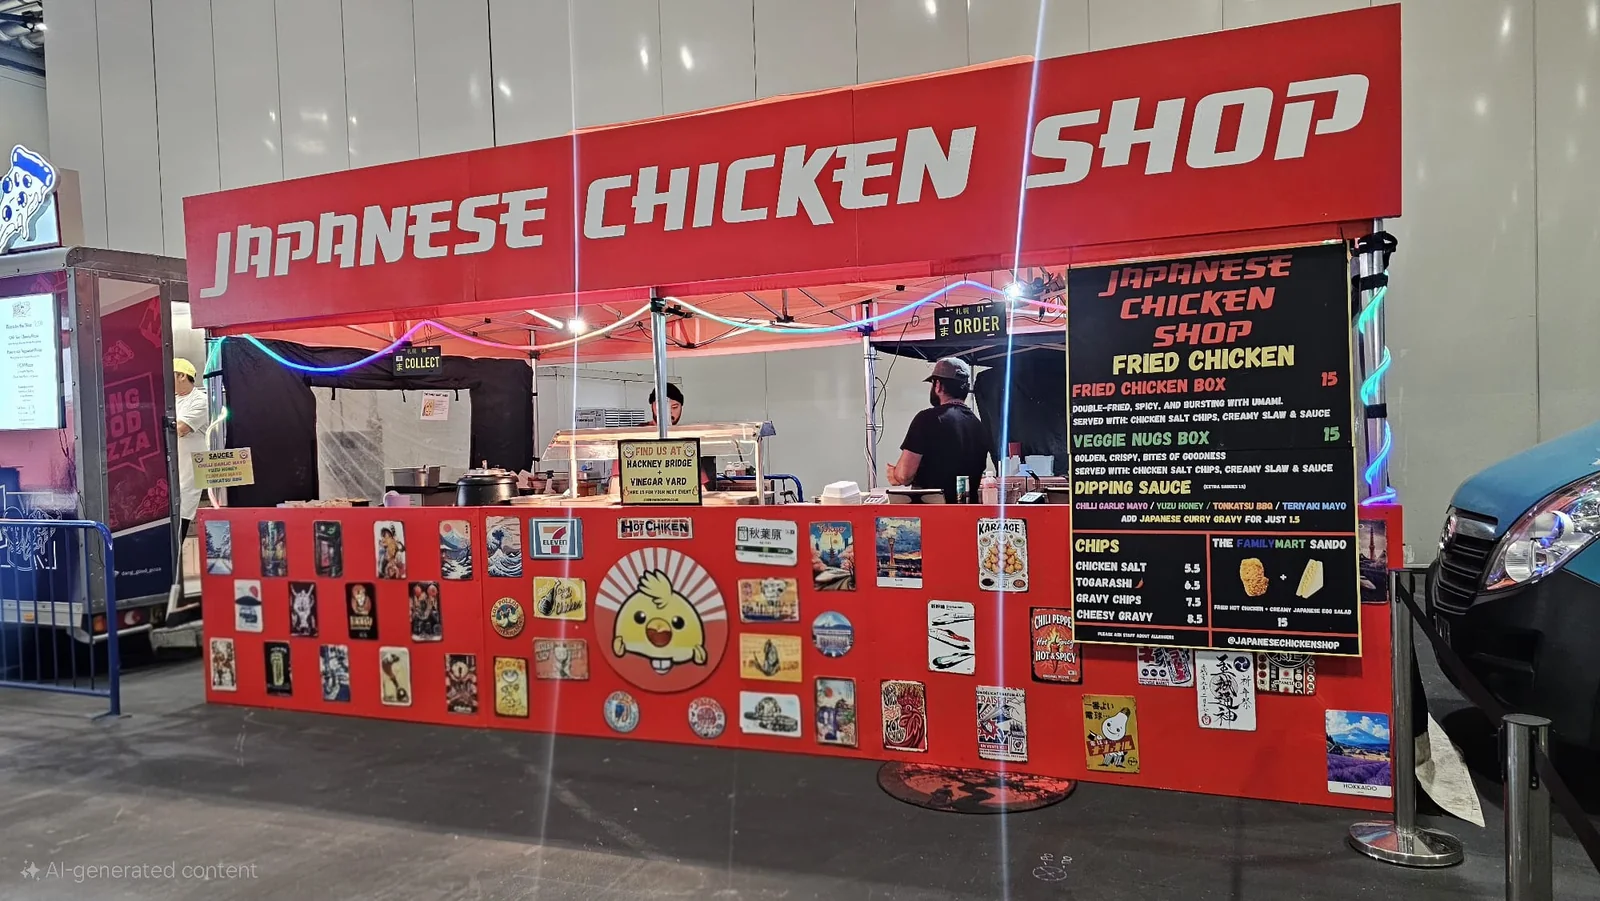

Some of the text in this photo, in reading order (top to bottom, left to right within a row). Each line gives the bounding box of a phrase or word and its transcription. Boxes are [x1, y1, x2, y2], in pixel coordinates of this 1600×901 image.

[200, 73, 1369, 298] JAPANESE CHICKEN SHOP
[1098, 254, 1293, 297] JAPANESE
[1119, 287, 1276, 320] CHICKEN
[954, 315, 1000, 335] ORDER
[1153, 320, 1252, 347] SHOP
[405, 356, 440, 369] COLLECT
[1112, 345, 1295, 375] FRIED CHICKEN
[1072, 371, 1338, 397] FRIED CHICKEN BOX 15
[109, 387, 140, 415] NG
[1072, 403, 1133, 413] DOUBLE-FRIED,
[1164, 401, 1181, 409] AND
[1183, 399, 1225, 409] BURSTING
[1227, 398, 1250, 407] WITH
[107, 410, 142, 438] OD
[1072, 409, 1331, 426] SERVED WITH: CHICKEN SALT CHIPS, CREAMY SLAW & SAUCE
[1073, 426, 1341, 448] VEGGIE NUGS BOX 15
[107, 431, 151, 462] ZZA
[635, 446, 682, 456] FIND US AT
[626, 459, 692, 469] HACKNEY BRIDGE
[1074, 451, 1227, 463] GOLDEN, CRISPY, BITES OF GOODNESS
[1075, 463, 1334, 475] SERVED WITH: CHICKEN SALT CHIPS, CREAMY SLAW & SAUCE
[630, 477, 687, 487] VINEGAR YARD
[1074, 480, 1134, 495] DIPPING
[1139, 479, 1192, 494] SAUCE
[1075, 502, 1097, 510] CHILLI
[1098, 502, 1124, 510] GARLIC
[1126, 501, 1148, 510] MAYO
[1149, 501, 1154, 510] /
[1156, 502, 1177, 510] YUZU
[1178, 502, 1204, 510] HONEY
[1213, 502, 1254, 510] TONKATSU
[1256, 502, 1273, 510] BBQ
[1275, 501, 1280, 510] /
[1282, 502, 1320, 510] TERIYAKI
[1322, 502, 1347, 510] MAYO
[1121, 515, 1300, 523] ADD JAPANESE CURRY GRAVY FOR JUST 1.5
[749, 527, 782, 541] 秋葉原
[1075, 538, 1120, 553] CHIPS
[1212, 538, 1347, 549] THE FAMILYMART SANDO
[1075, 561, 1201, 573] CHICKEN SALT 5.5
[1075, 577, 1201, 590] TOGARASHI 6.5
[1076, 593, 1201, 607] GRAVY CHIPS 7.5
[1034, 614, 1072, 630] CHILI PEPPE
[1076, 609, 1203, 624] CHEESY GRAVY 8.5
[1277, 617, 1288, 628] 15
[1227, 636, 1340, 650] @JAPANESECHICKENSHOP
[1035, 650, 1050, 661] HOT
[1056, 652, 1076, 664] SPICY
[1084, 701, 1114, 710] 一番よい
[1343, 783, 1378, 791] HOKKAIDO
